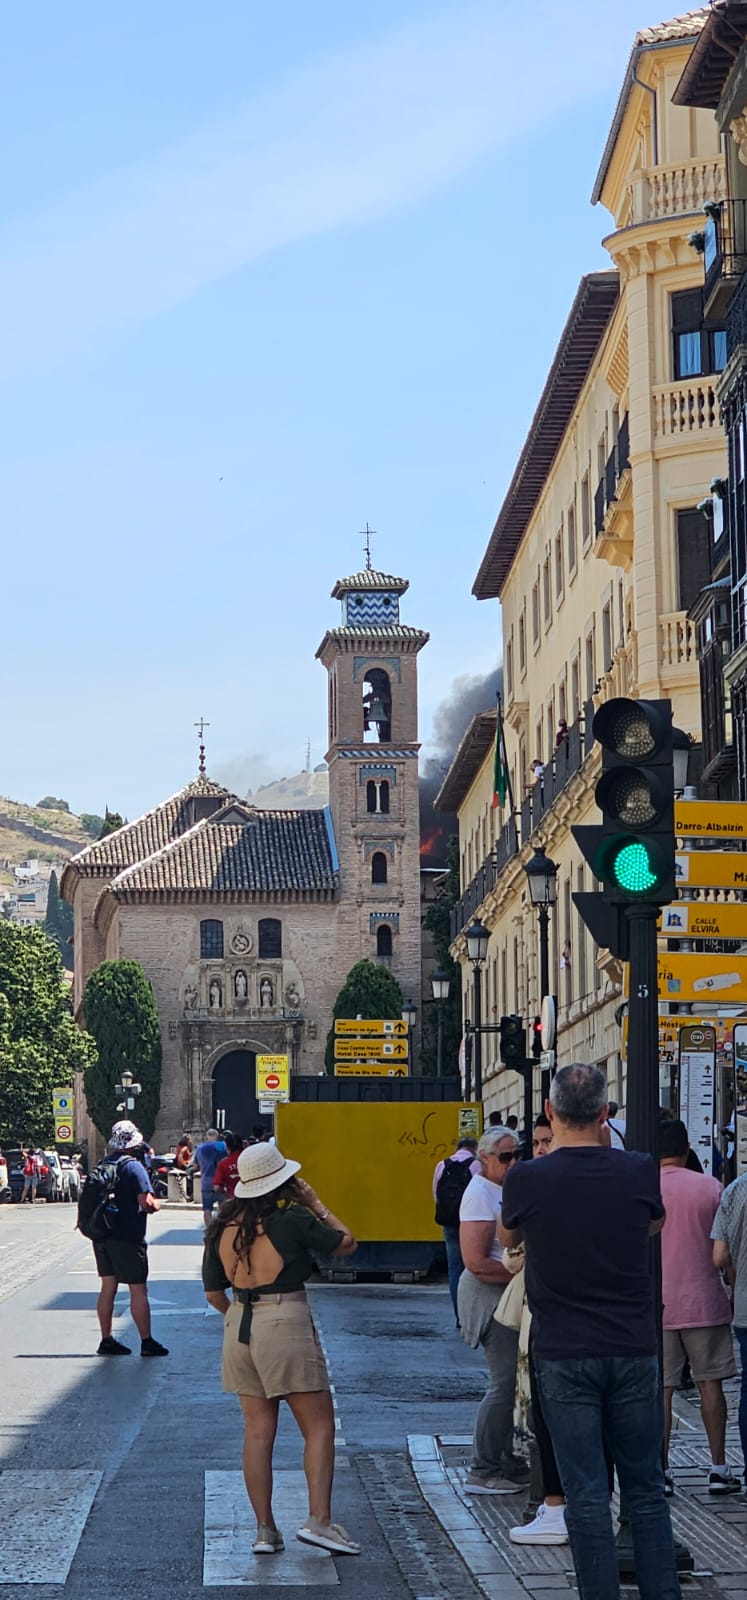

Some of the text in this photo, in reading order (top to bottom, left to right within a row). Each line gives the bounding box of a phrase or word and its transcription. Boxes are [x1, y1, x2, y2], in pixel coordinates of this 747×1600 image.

[690, 925, 720, 933] ELVIRA
[658, 970, 673, 980] ria
[638, 984, 648, 998] 5
